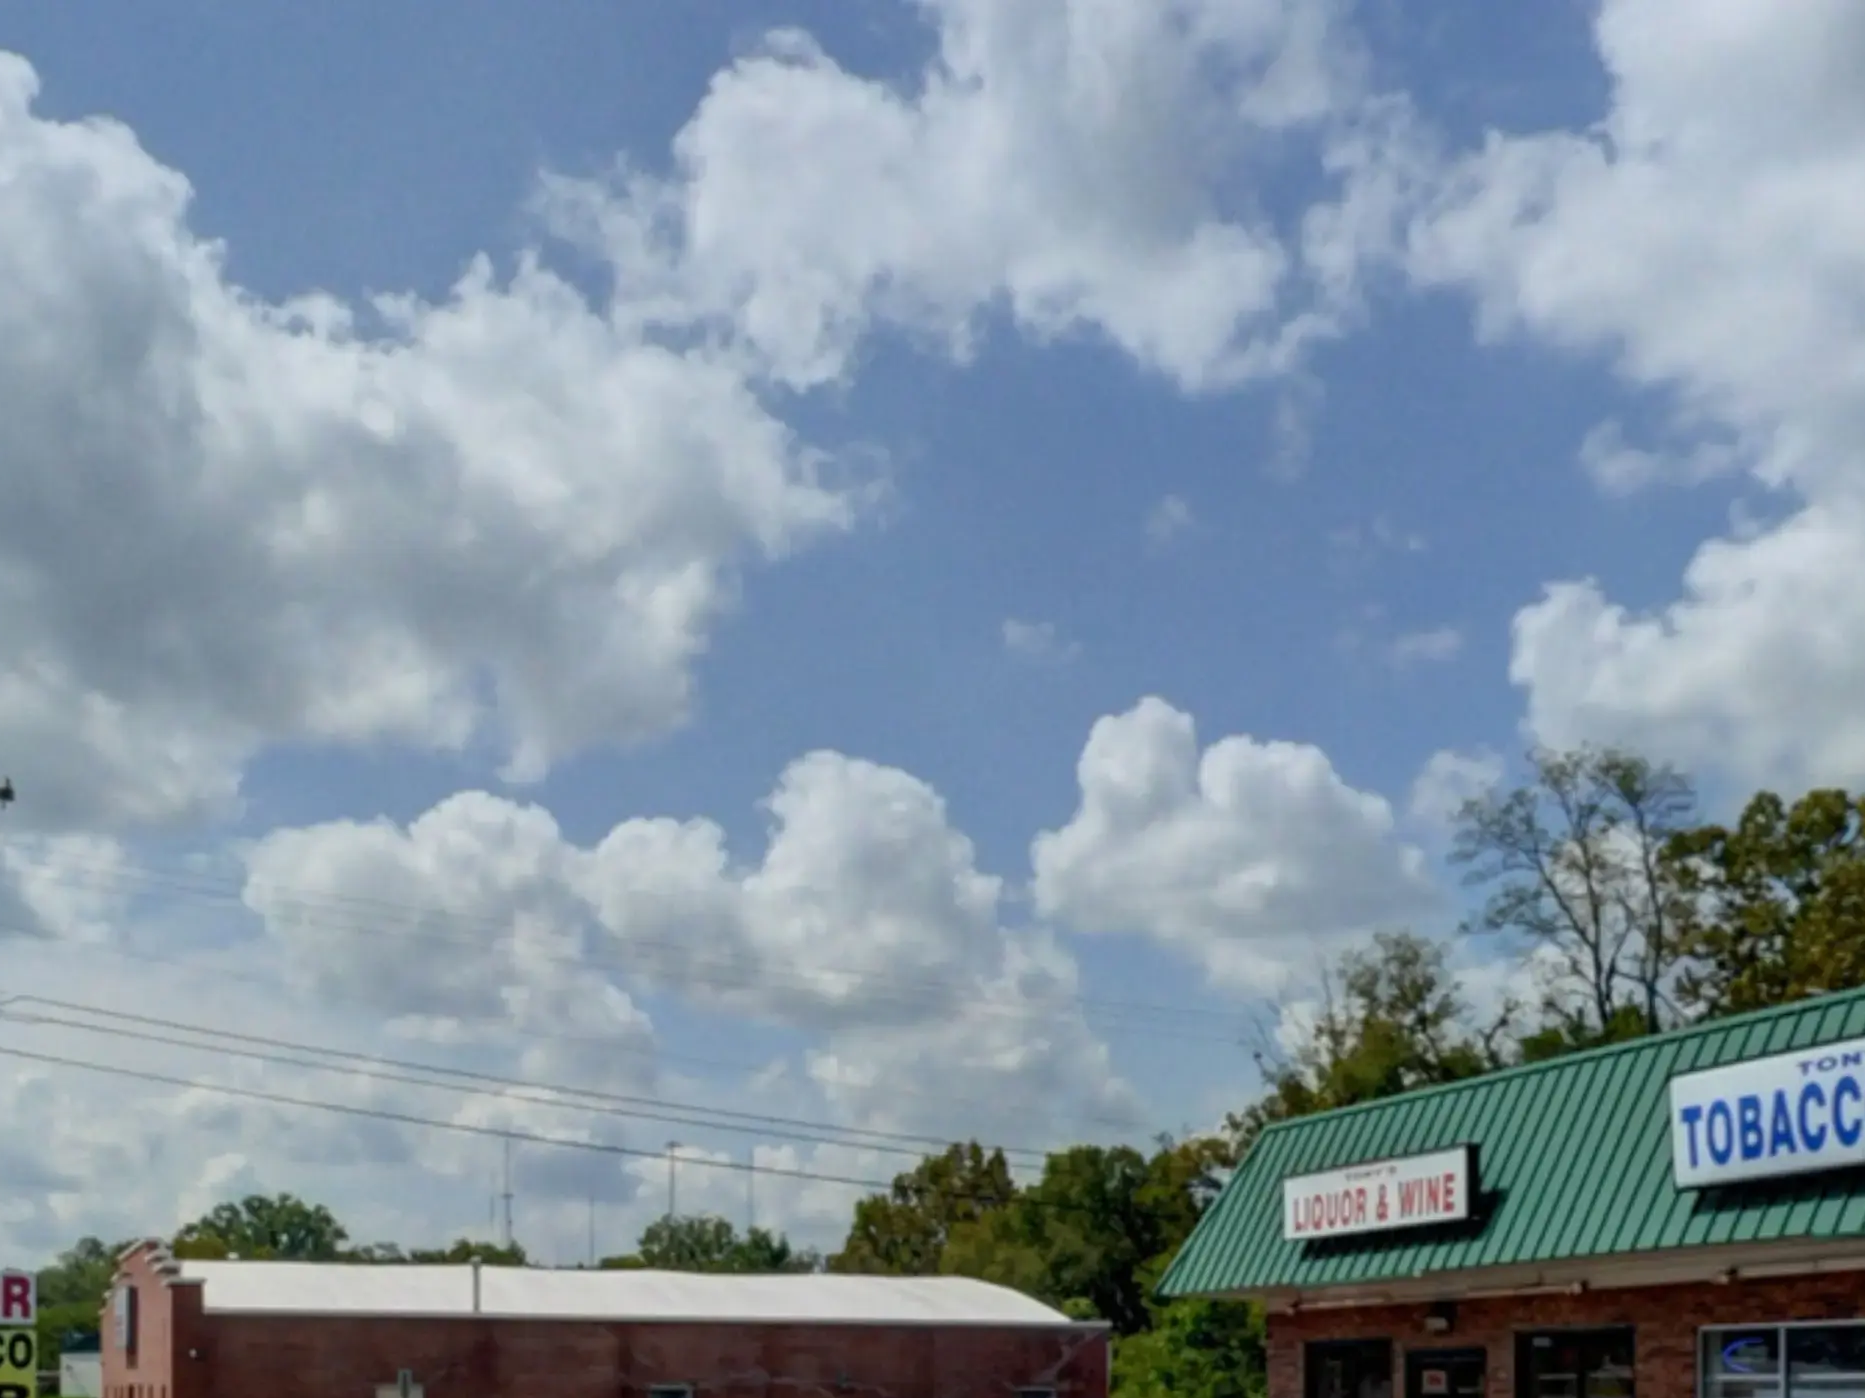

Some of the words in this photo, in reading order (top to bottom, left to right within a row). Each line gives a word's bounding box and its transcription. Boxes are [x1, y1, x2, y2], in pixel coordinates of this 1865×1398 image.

[1293, 1187, 1367, 1232] LIQUOR
[1376, 1183, 1389, 1222] &
[1398, 1172, 1455, 1218] WINE
